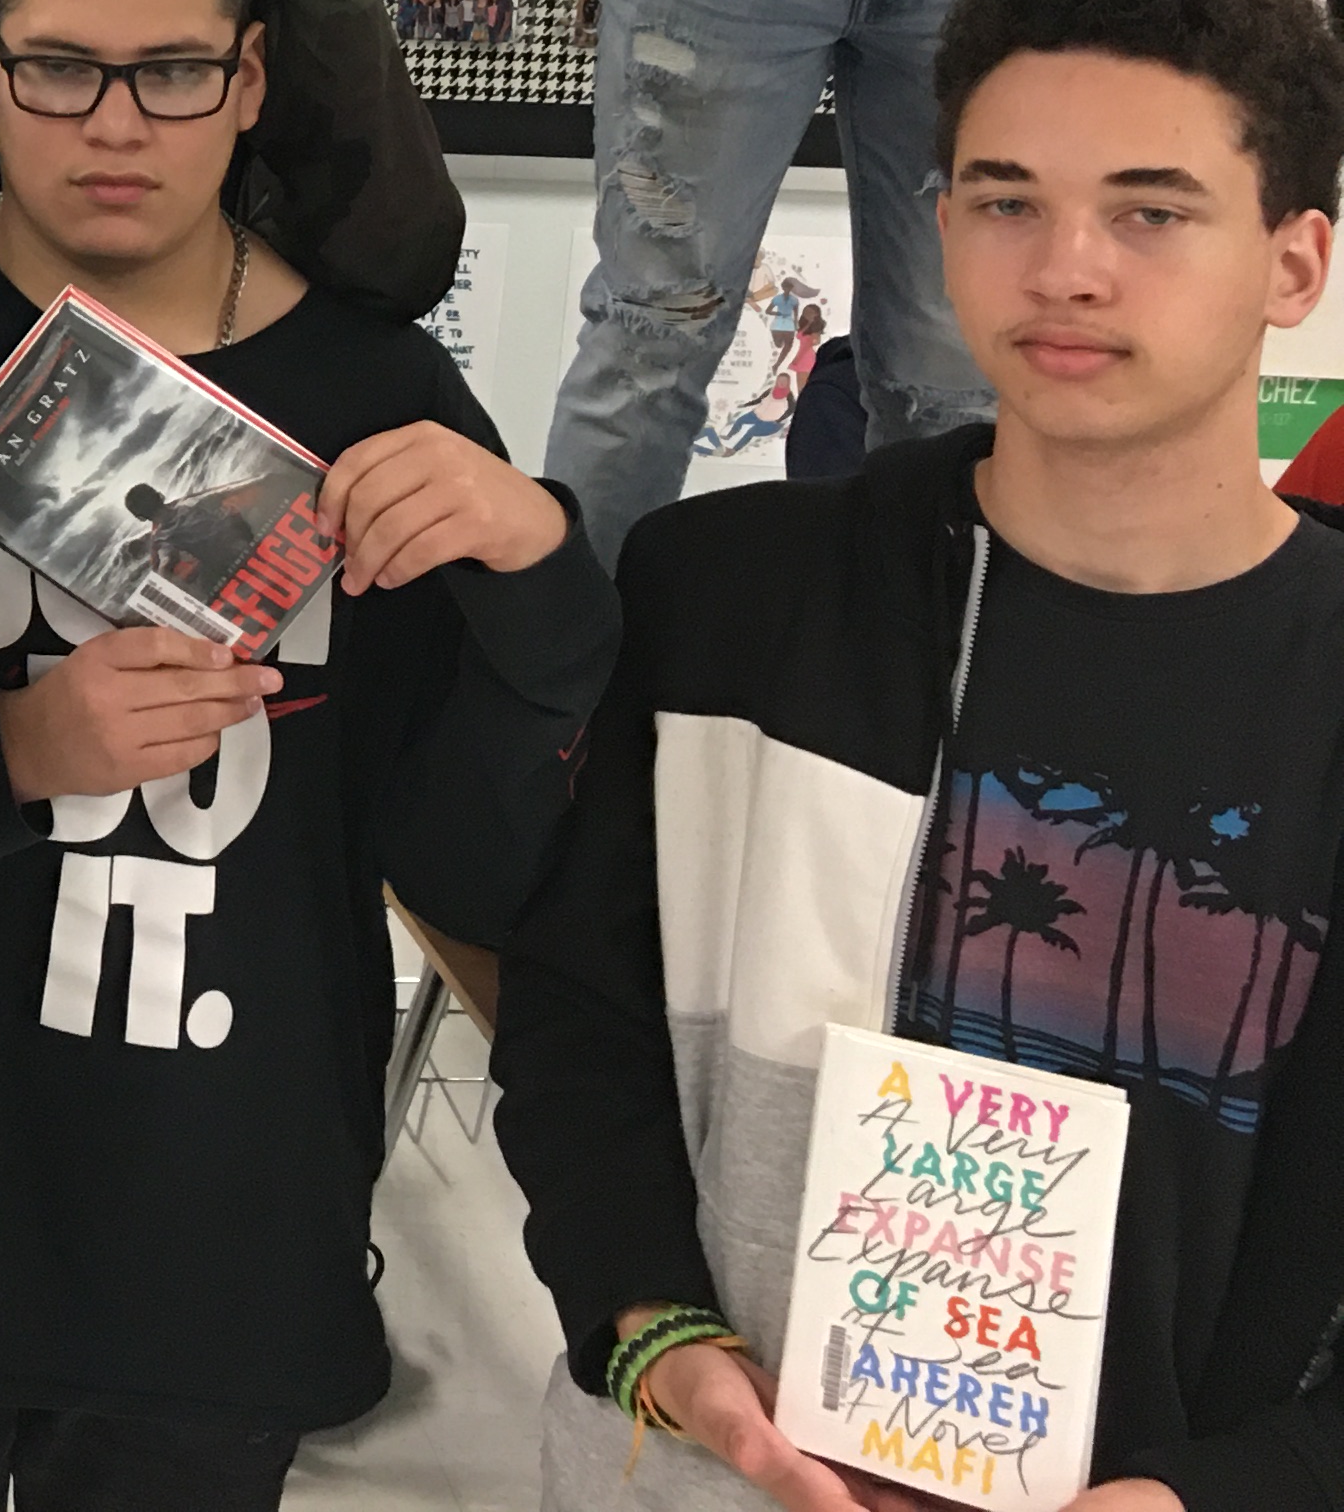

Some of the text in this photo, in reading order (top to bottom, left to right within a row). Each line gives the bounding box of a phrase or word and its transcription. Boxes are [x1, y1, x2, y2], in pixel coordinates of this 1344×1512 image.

[26, 348, 91, 425] GRATZ
[1258, 375, 1320, 405] CHEZ
[40, 852, 234, 1049] IT.
[878, 1061, 1071, 1142] A VERY
[861, 1143, 1076, 1254] Large
[883, 1133, 1048, 1211] LARGE
[947, 1108, 1090, 1206] Very
[807, 1206, 1101, 1319] Expanse
[836, 1192, 1078, 1294] EXPANSE
[849, 1269, 1042, 1361] OF SEA
[851, 1344, 1050, 1438] AHEREH
[861, 1419, 997, 1495] MAFI
